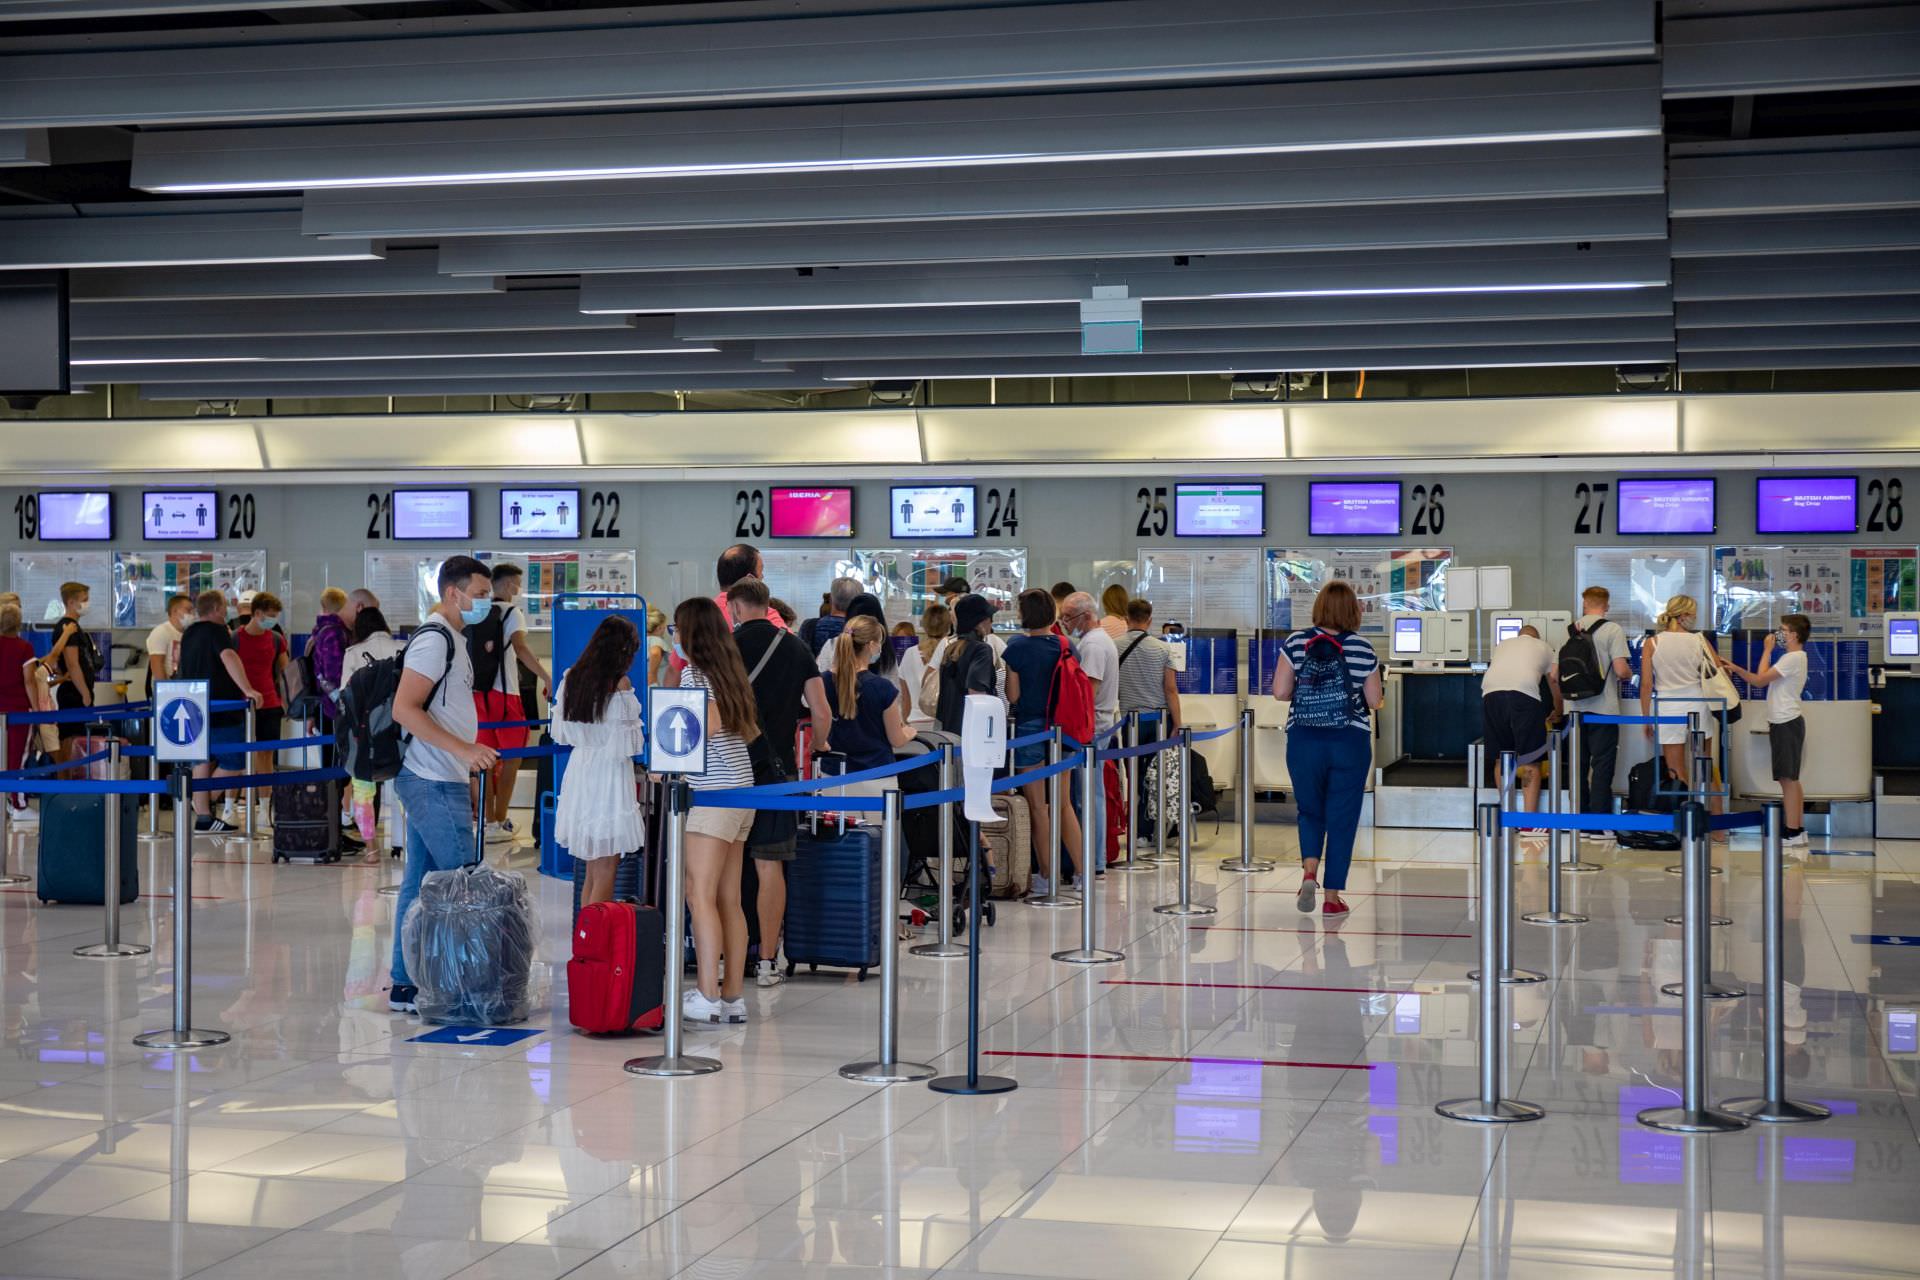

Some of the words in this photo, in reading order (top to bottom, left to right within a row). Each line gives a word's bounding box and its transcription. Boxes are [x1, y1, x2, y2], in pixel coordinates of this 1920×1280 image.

[14, 494, 37, 539] 19
[228, 493, 255, 539] 20
[367, 493, 390, 539] 21
[591, 491, 620, 538] 22
[736, 490, 765, 538] 23
[986, 488, 1019, 536] 24
[1136, 488, 1169, 537] 25
[1411, 484, 1445, 536] 26
[1574, 482, 1609, 534] 27
[1866, 478, 1904, 533] 28
